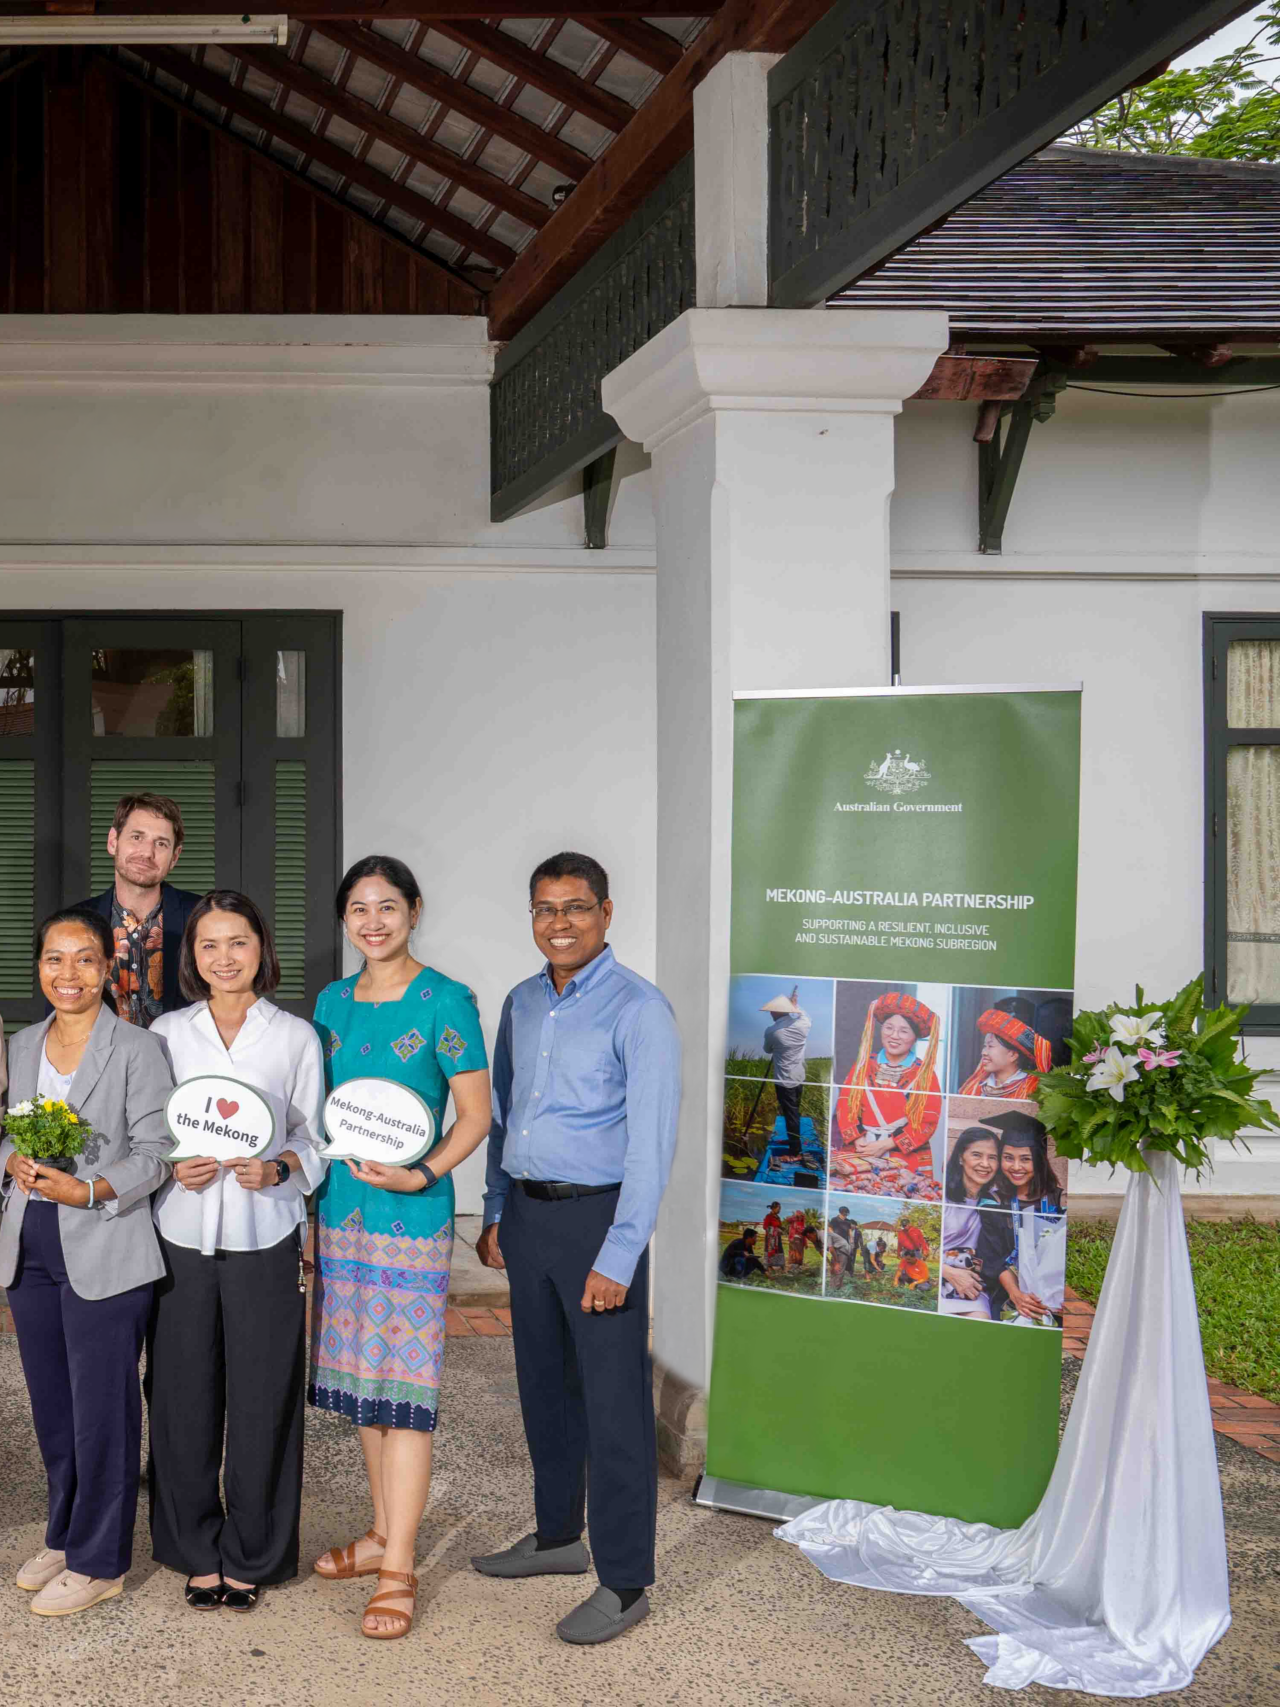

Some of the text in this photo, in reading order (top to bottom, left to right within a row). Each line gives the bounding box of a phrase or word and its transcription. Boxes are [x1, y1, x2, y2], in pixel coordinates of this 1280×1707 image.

[833, 802, 962, 812] Australian Government
[766, 889, 1034, 909] MEKONG-AUSTRALIA PARTNERSHIP
[803, 919, 989, 935] SUPPORTING A RESILIENT, INCLUSIVE
[795, 933, 997, 950] AND SUSTAINABLE MEKONG SUBREGION
[205, 1097, 212, 1113] I
[330, 1096, 426, 1137] Mekong-Australia
[176, 1113, 259, 1148] the Mekong
[339, 1119, 404, 1150] Partnership
